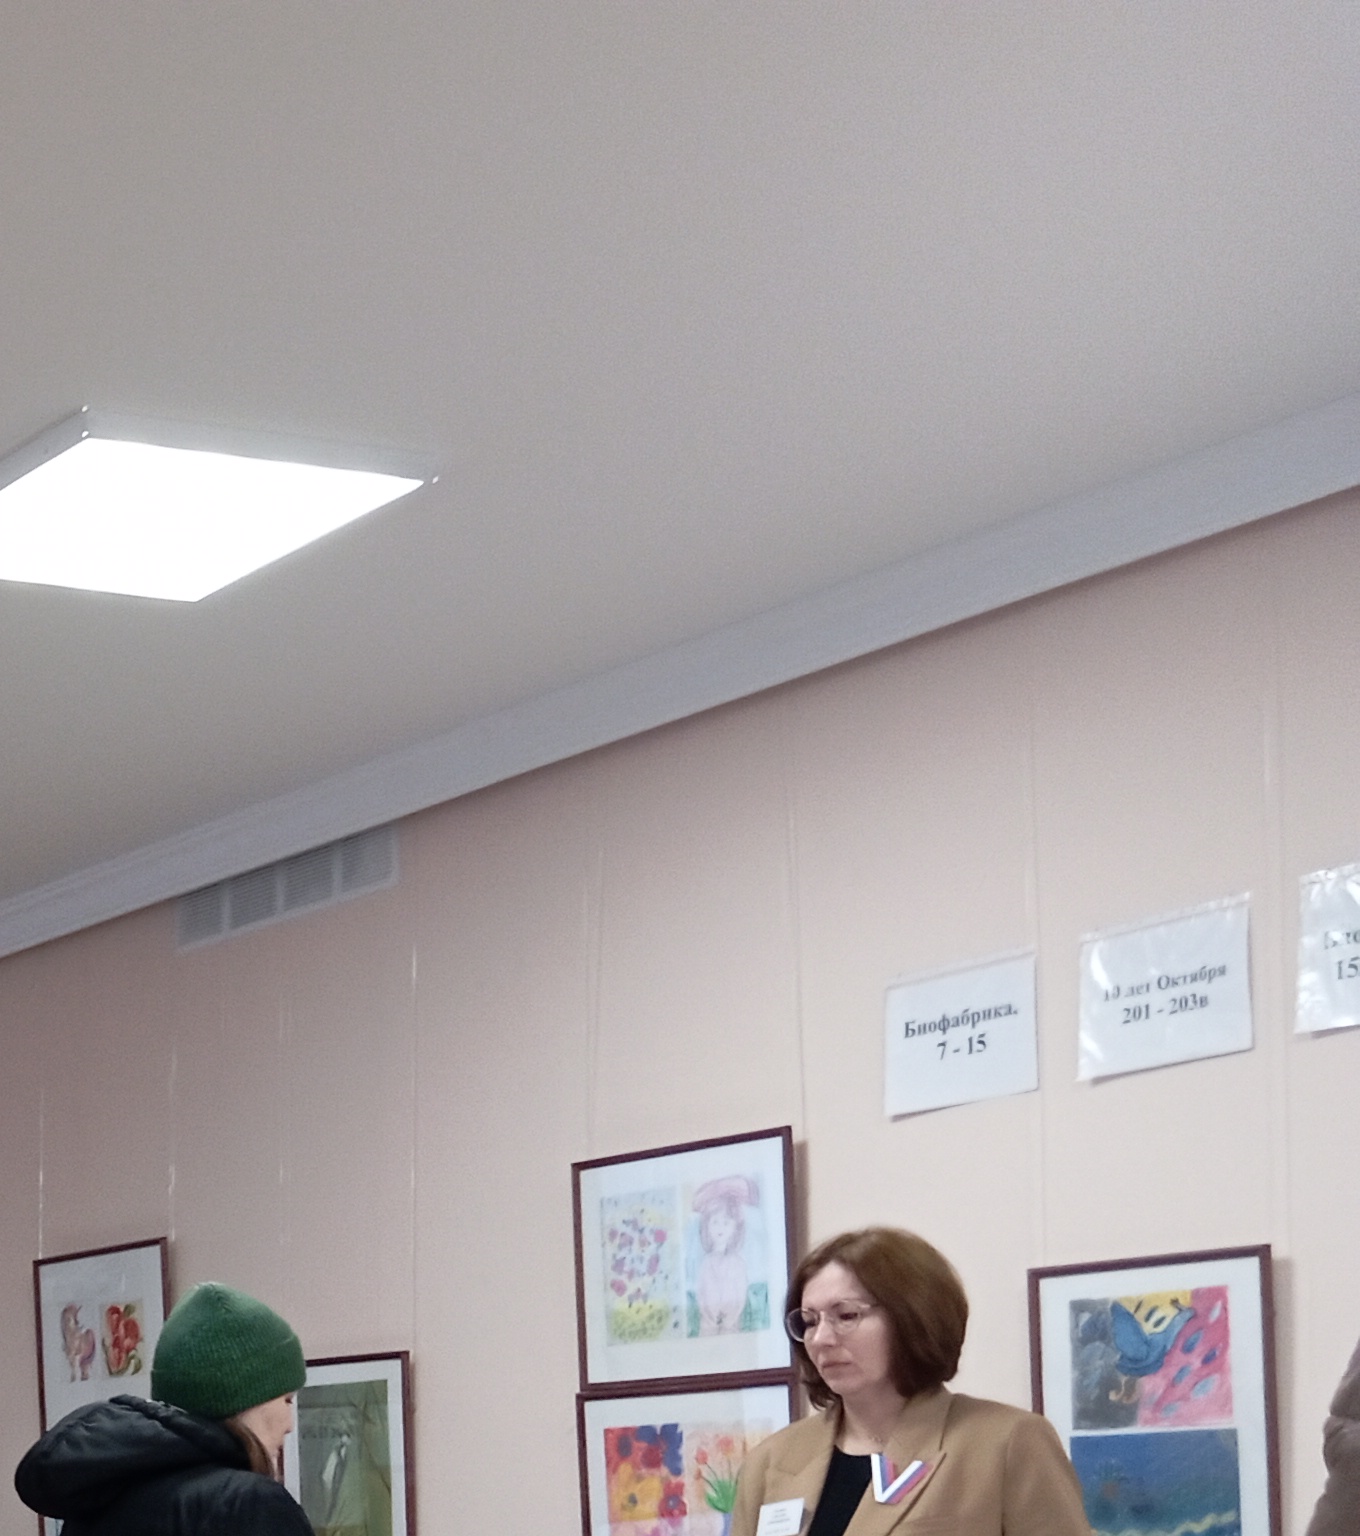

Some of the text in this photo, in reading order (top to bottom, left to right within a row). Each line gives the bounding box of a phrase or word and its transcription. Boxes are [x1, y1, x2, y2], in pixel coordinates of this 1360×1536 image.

[1157, 964, 1227, 991] Октября
[1122, 1003, 1150, 1025] 201
[937, 1041, 947, 1060] 7
[968, 1033, 987, 1055] 15
